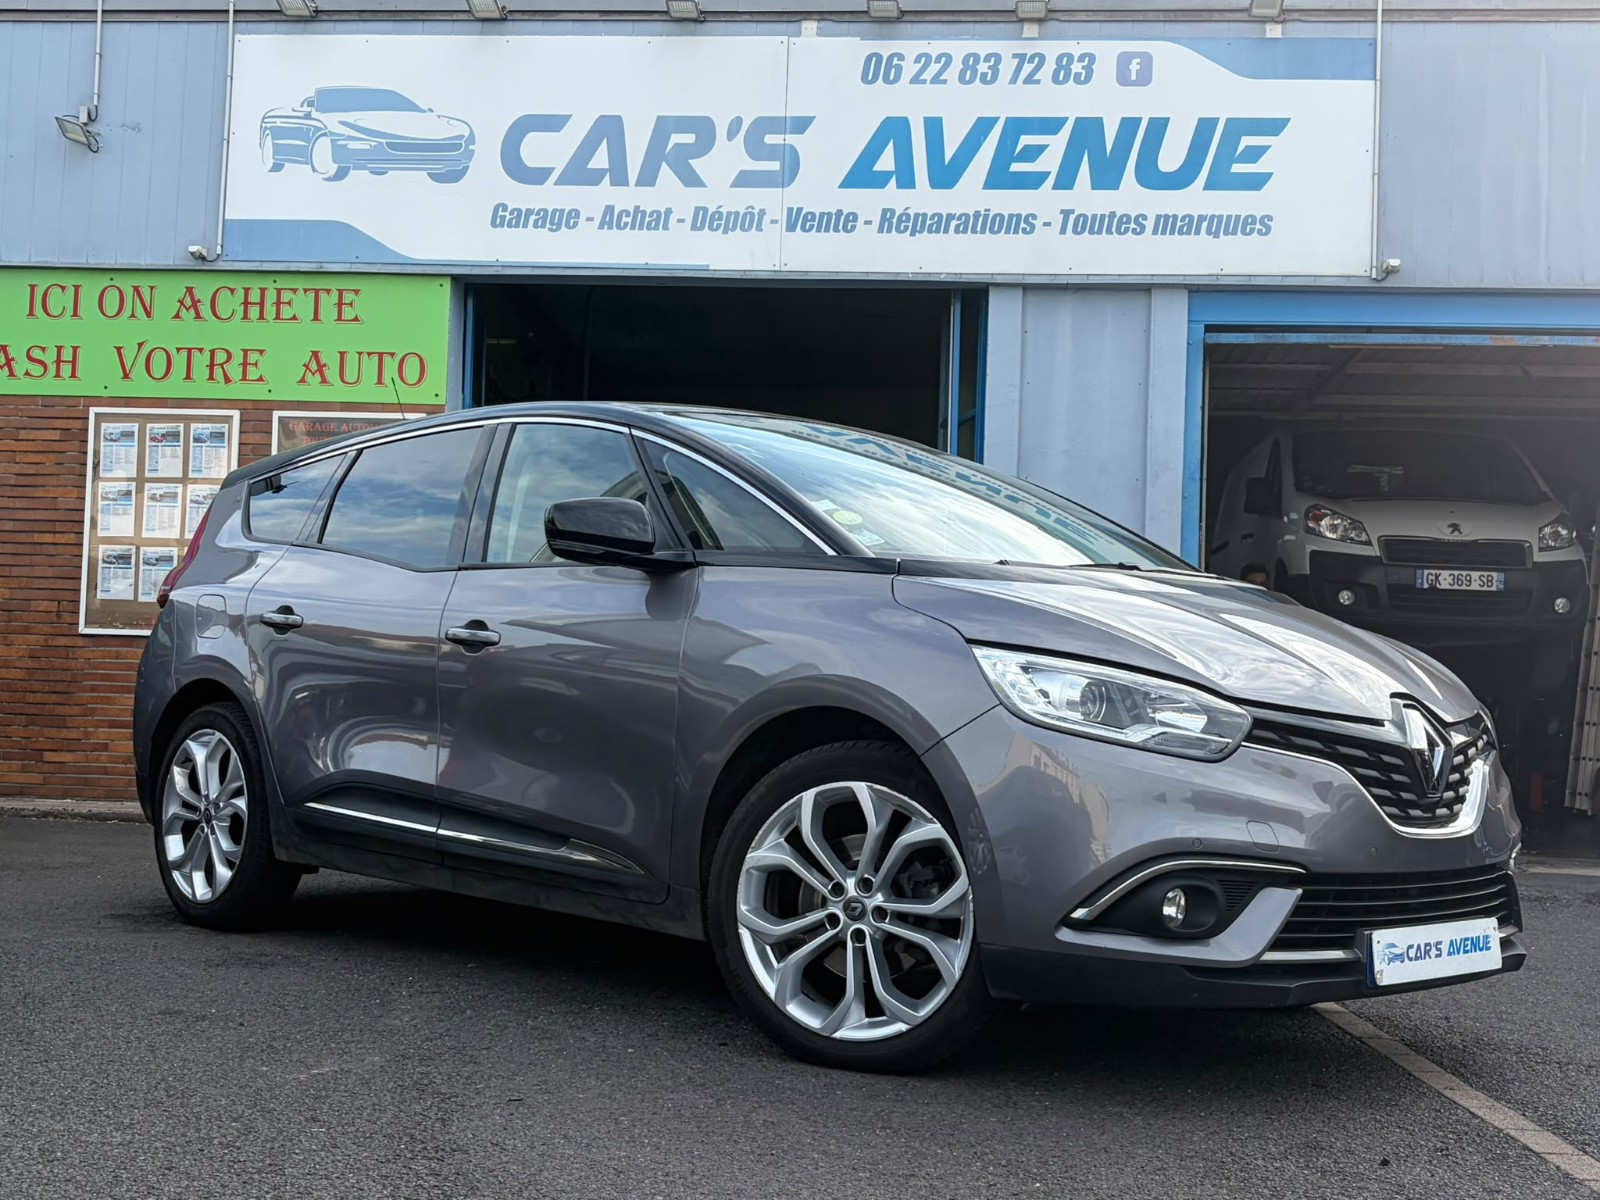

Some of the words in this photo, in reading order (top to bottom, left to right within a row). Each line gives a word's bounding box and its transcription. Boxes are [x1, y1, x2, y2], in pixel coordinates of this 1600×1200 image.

[861, 53, 907, 85] 06
[909, 53, 953, 85] 22
[957, 53, 1002, 85] 83
[1009, 53, 1047, 85] 72
[1051, 53, 1096, 85] 83
[500, 114, 815, 188] CAR'S
[837, 116, 1291, 191] AVENUE
[490, 203, 580, 233] Garage
[598, 205, 672, 231] Achat
[690, 206, 766, 235] Dépôt
[785, 207, 858, 234] Vente
[878, 207, 1037, 237] Réparations
[1059, 209, 1148, 236] Toutes
[1152, 214, 1273, 239] marques
[26, 284, 82, 320] ICI
[98, 285, 157, 320] ON
[171, 286, 364, 325] ACHETE
[113, 339, 267, 386] VOTRE
[297, 350, 428, 388] AUTO
[1426, 572, 1494, 588] GK-369-SB
[1406, 940, 1444, 962] CAR'S
[1446, 934, 1492, 957] AVENUE
